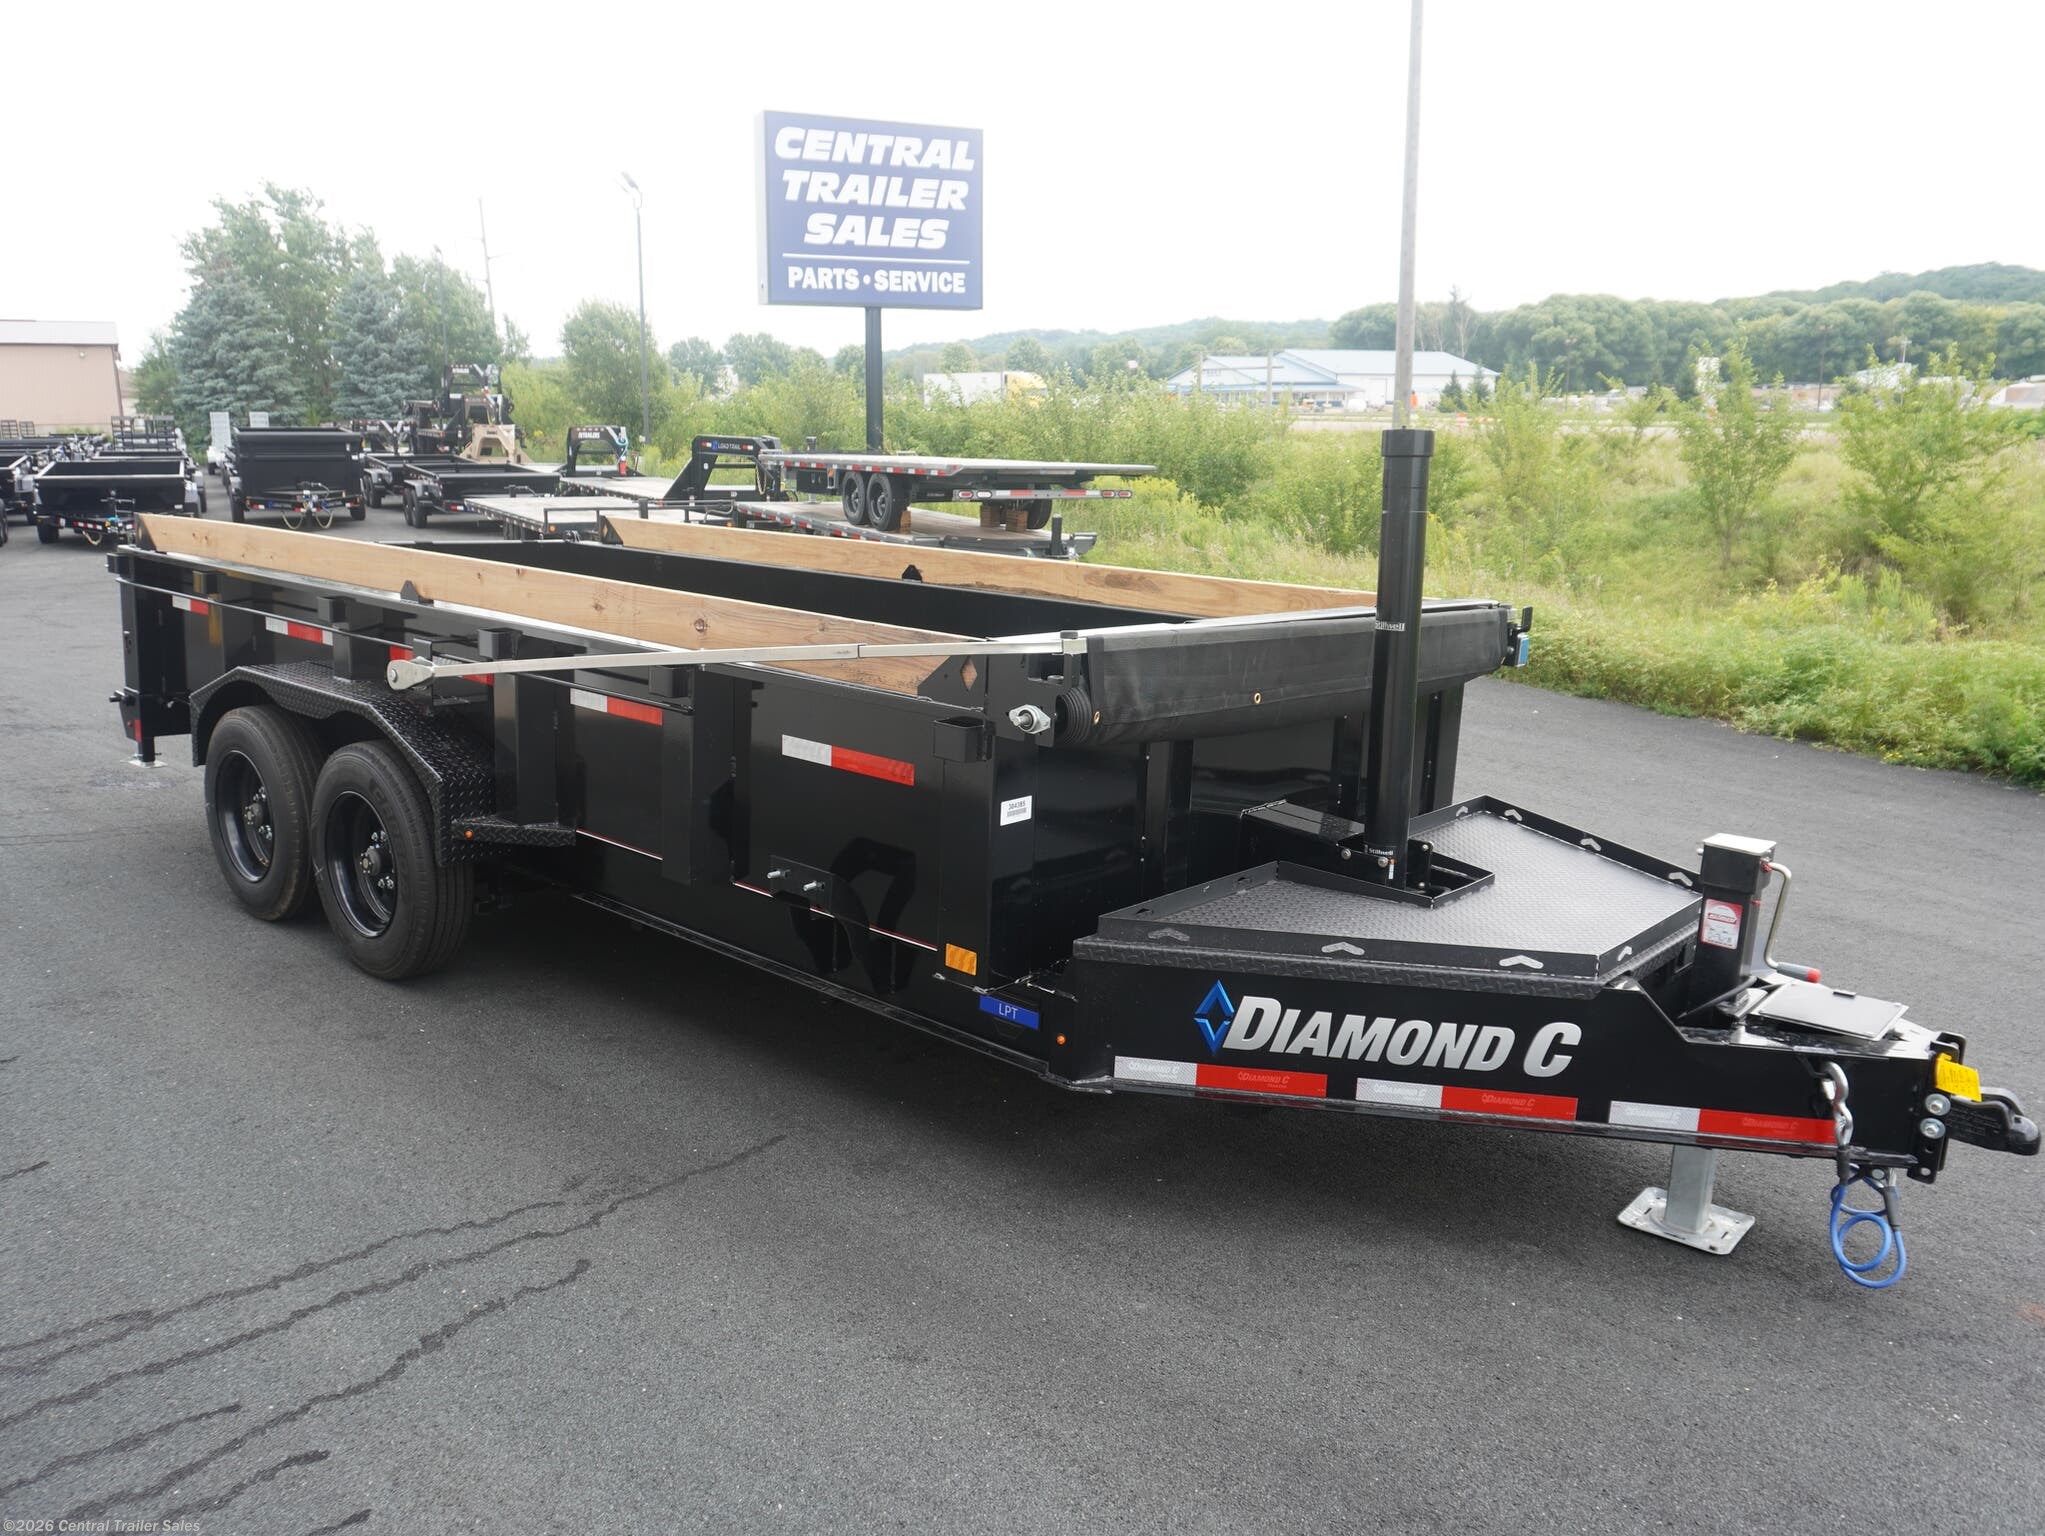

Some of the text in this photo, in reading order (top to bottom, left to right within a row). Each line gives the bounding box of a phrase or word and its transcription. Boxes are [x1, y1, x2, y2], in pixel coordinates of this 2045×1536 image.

[775, 126, 975, 171] CENTRAL
[782, 169, 969, 210] TRAILER
[803, 212, 950, 250] SALES
[787, 266, 967, 294] PARTS SERVICE
[998, 1002, 1019, 1020] LPT
[1222, 995, 1582, 1078] DIAMOND C
